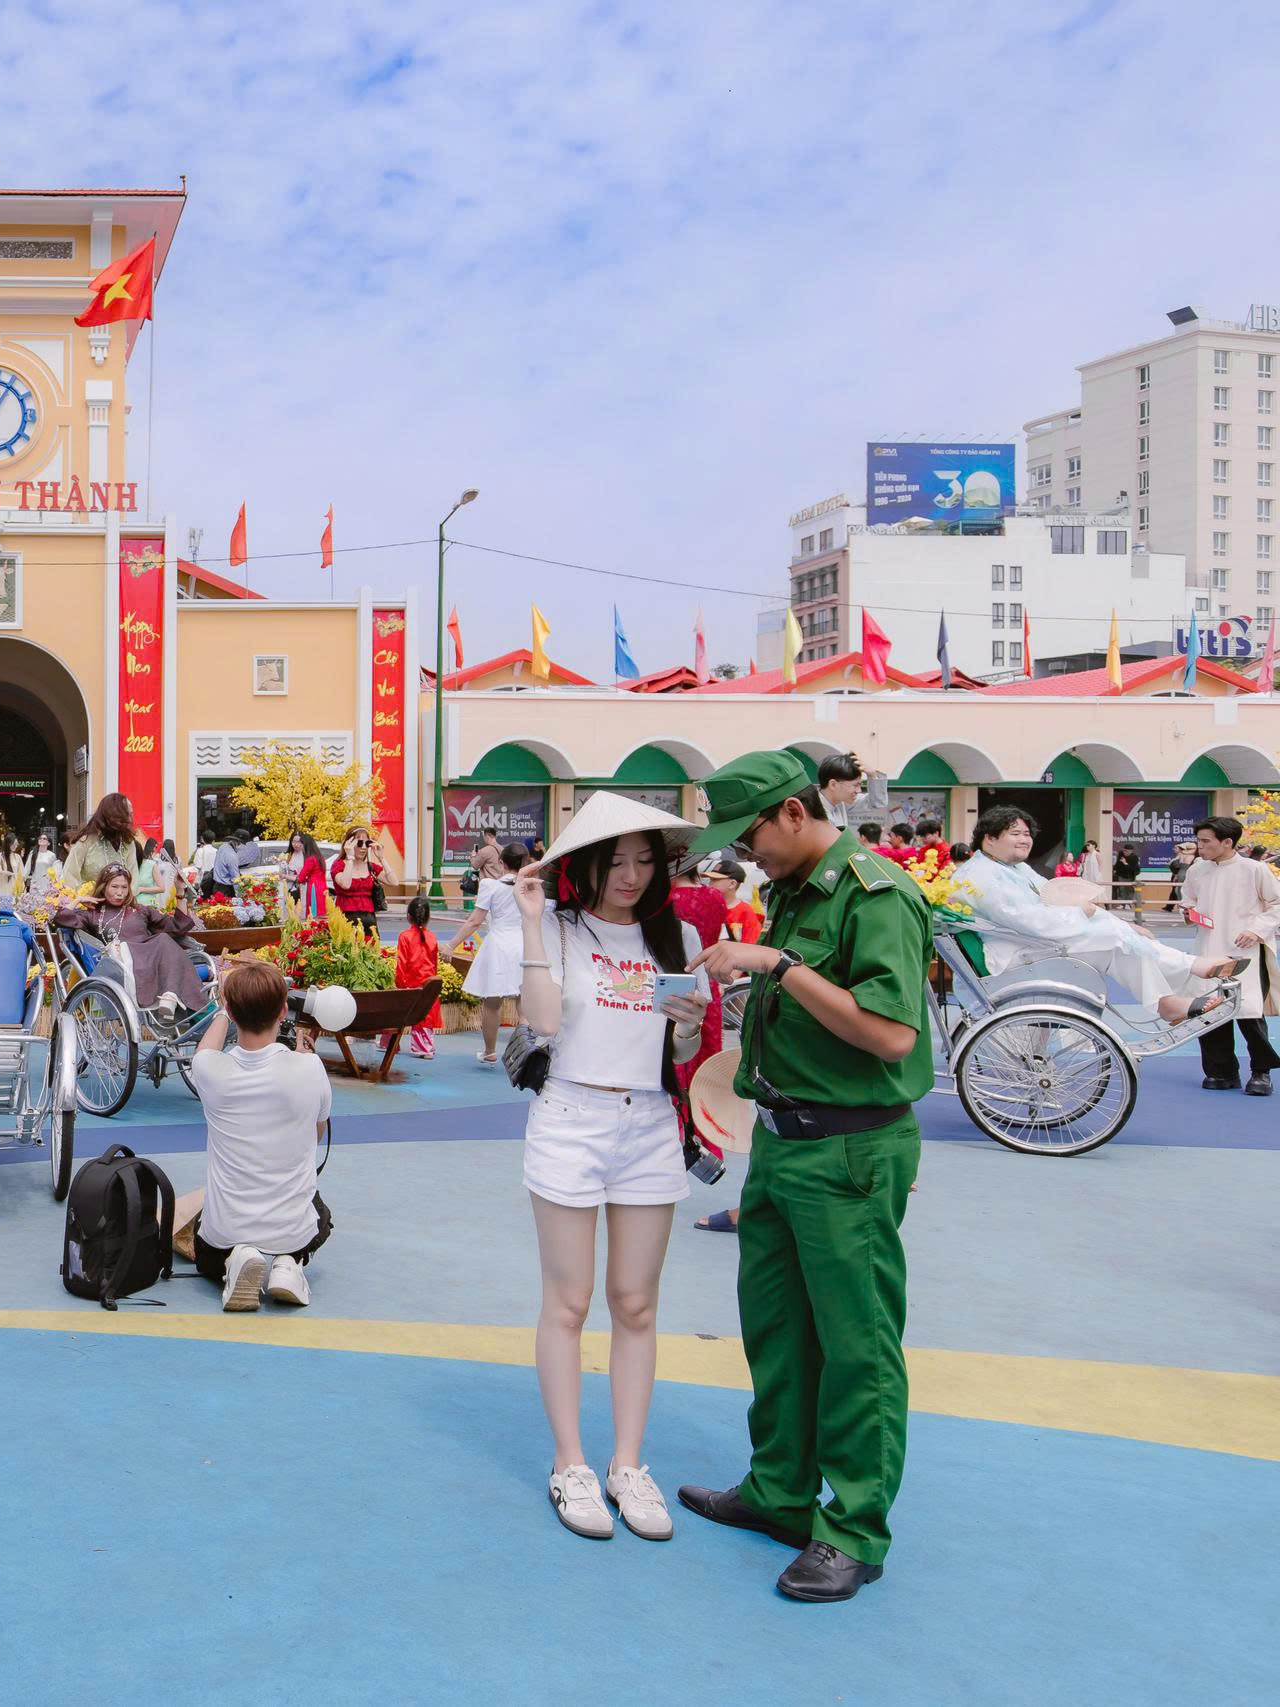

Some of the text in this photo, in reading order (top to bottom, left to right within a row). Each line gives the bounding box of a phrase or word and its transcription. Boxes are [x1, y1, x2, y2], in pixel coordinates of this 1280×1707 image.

[25, 408, 38, 424] 3
[15, 475, 138, 512] THÀNH
[119, 611, 160, 650] Happy
[124, 735, 155, 753] 2026
[448, 795, 508, 829] Vikki
[509, 813, 531, 821] Digital
[1113, 801, 1171, 835] Vikki
[509, 820, 537, 830] Bank
[1172, 818, 1195, 826] Digital
[1172, 824, 1195, 835] Ban
[596, 997, 653, 1012] Thành Côn
